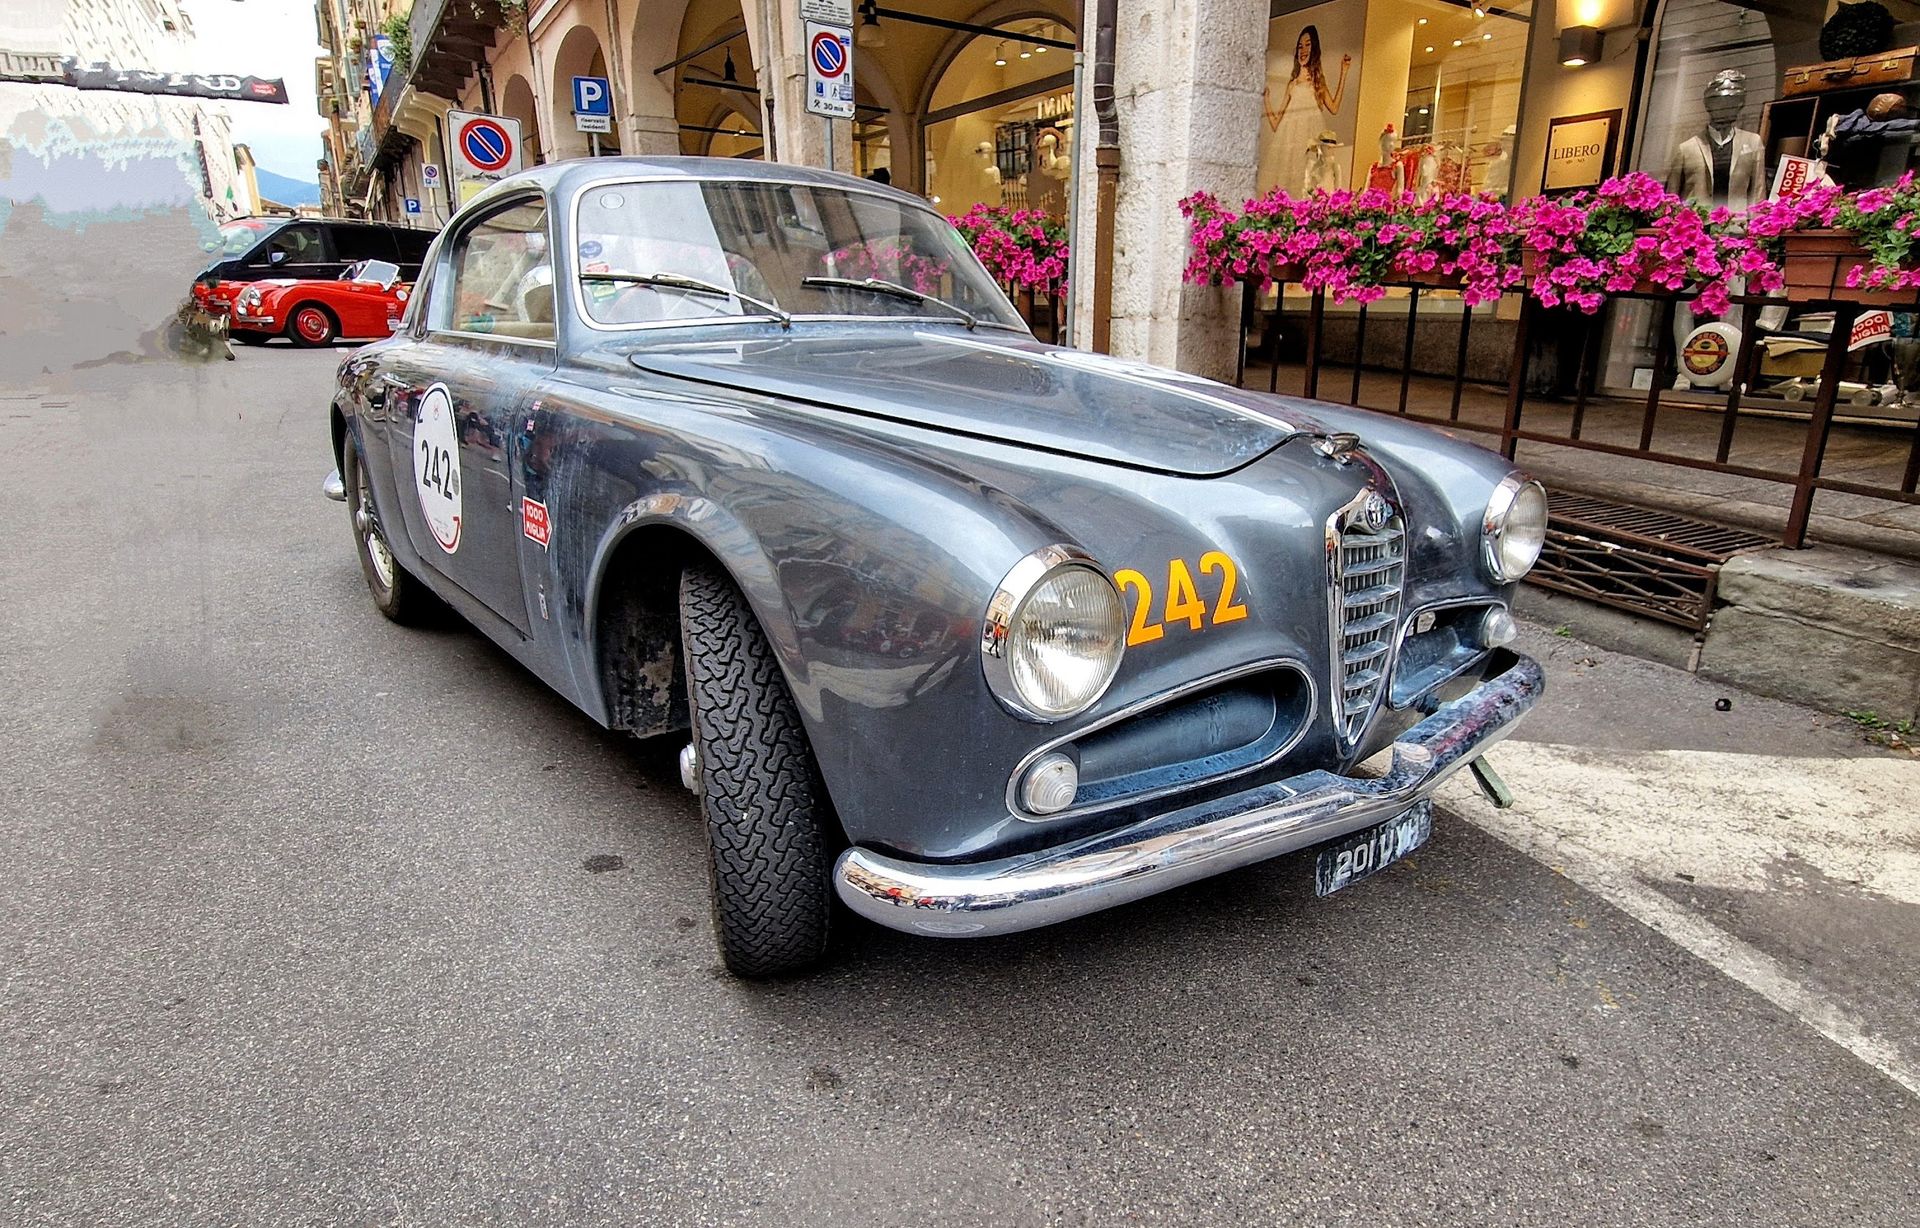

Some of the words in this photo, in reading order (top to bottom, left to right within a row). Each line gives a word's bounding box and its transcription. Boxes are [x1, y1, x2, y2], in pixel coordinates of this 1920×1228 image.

[580, 81, 602, 110] P
[823, 102, 833, 110] 30
[1553, 143, 1600, 160] LIBERO
[1781, 162, 1797, 192] 1000
[407, 200, 418, 211] P
[1851, 324, 1890, 343] MIGLIA
[1852, 315, 1884, 333] 1000
[421, 439, 453, 501] 242
[526, 504, 544, 523] 1000
[525, 520, 546, 541] MIGLIA
[1113, 550, 1248, 648] 242
[1335, 838, 1377, 882] 201
